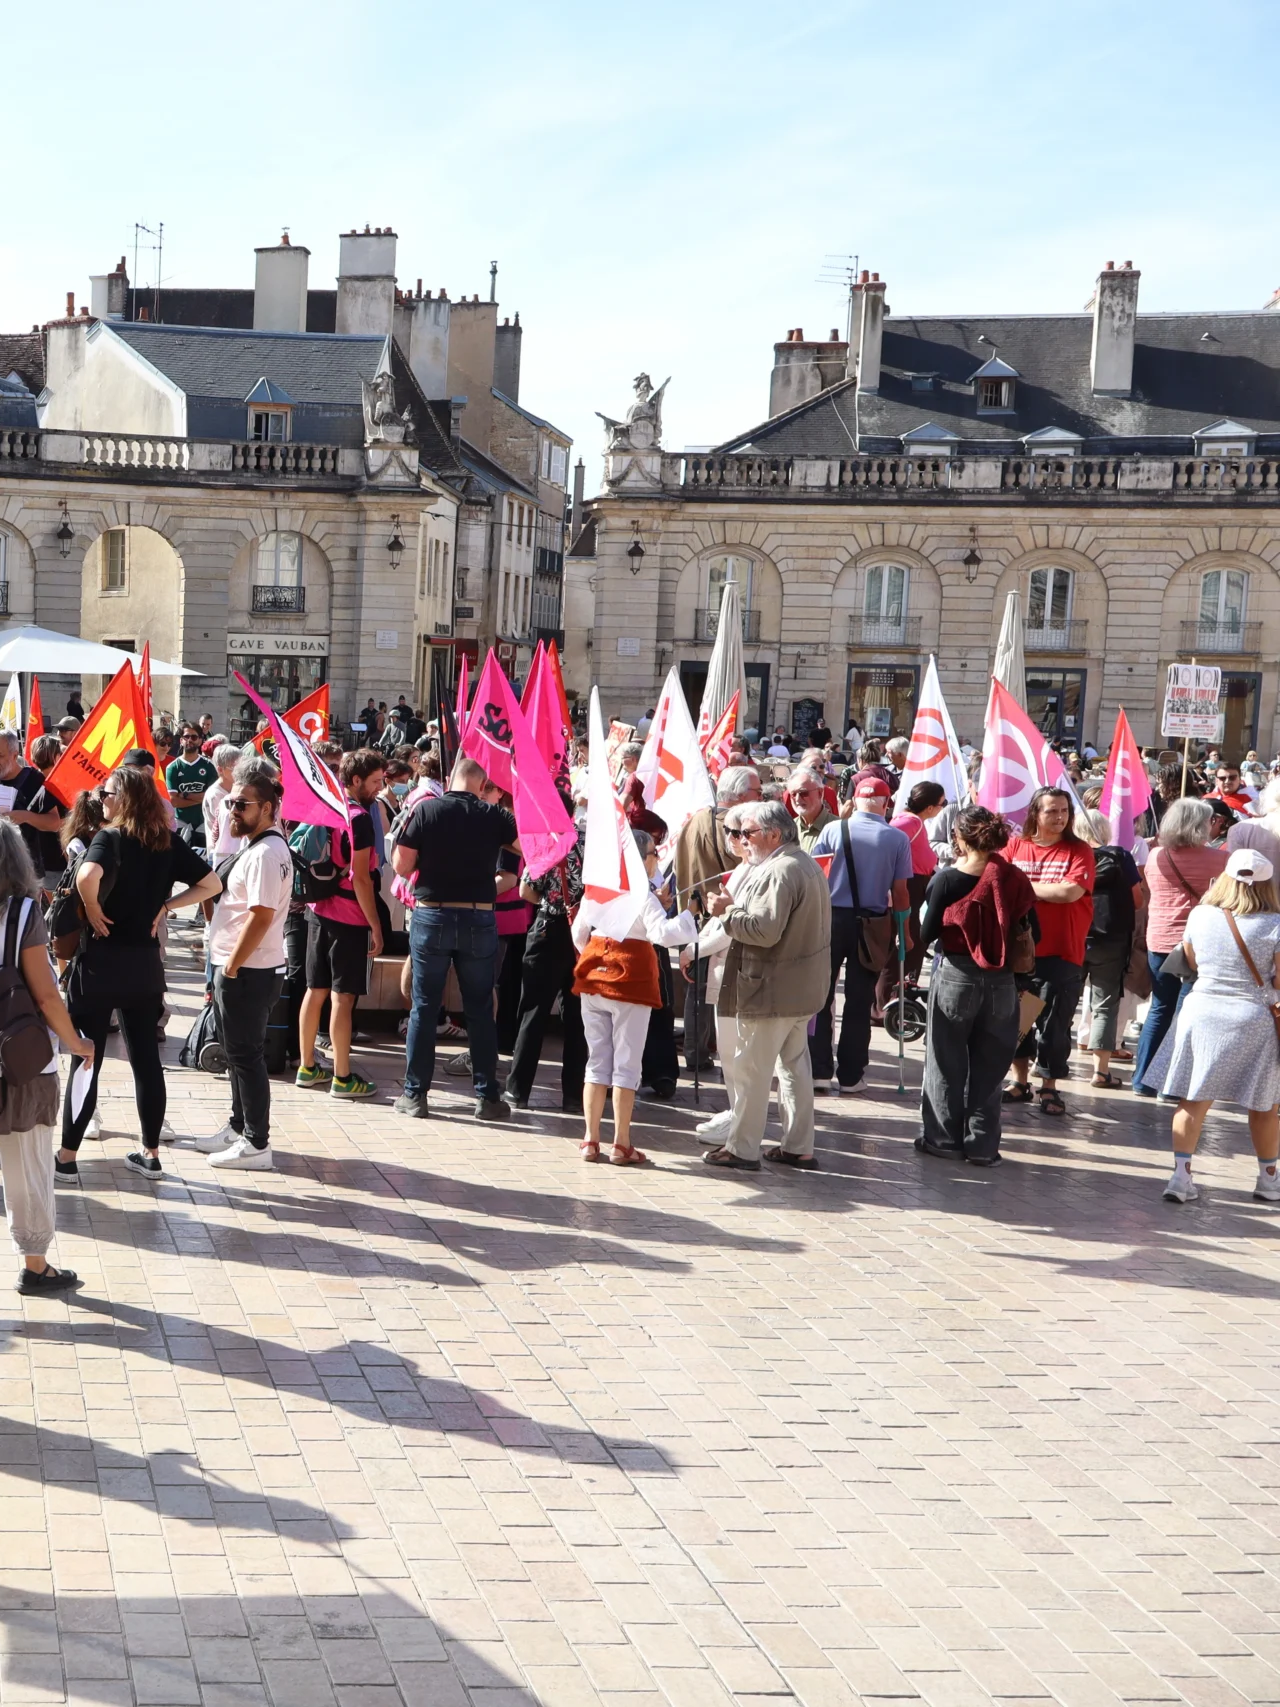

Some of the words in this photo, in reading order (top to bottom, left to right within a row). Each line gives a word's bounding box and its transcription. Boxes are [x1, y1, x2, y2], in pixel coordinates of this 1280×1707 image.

[229, 639, 265, 650] CAVE
[274, 640, 326, 651] VAUBAN
[179, 782, 206, 792] VICE
